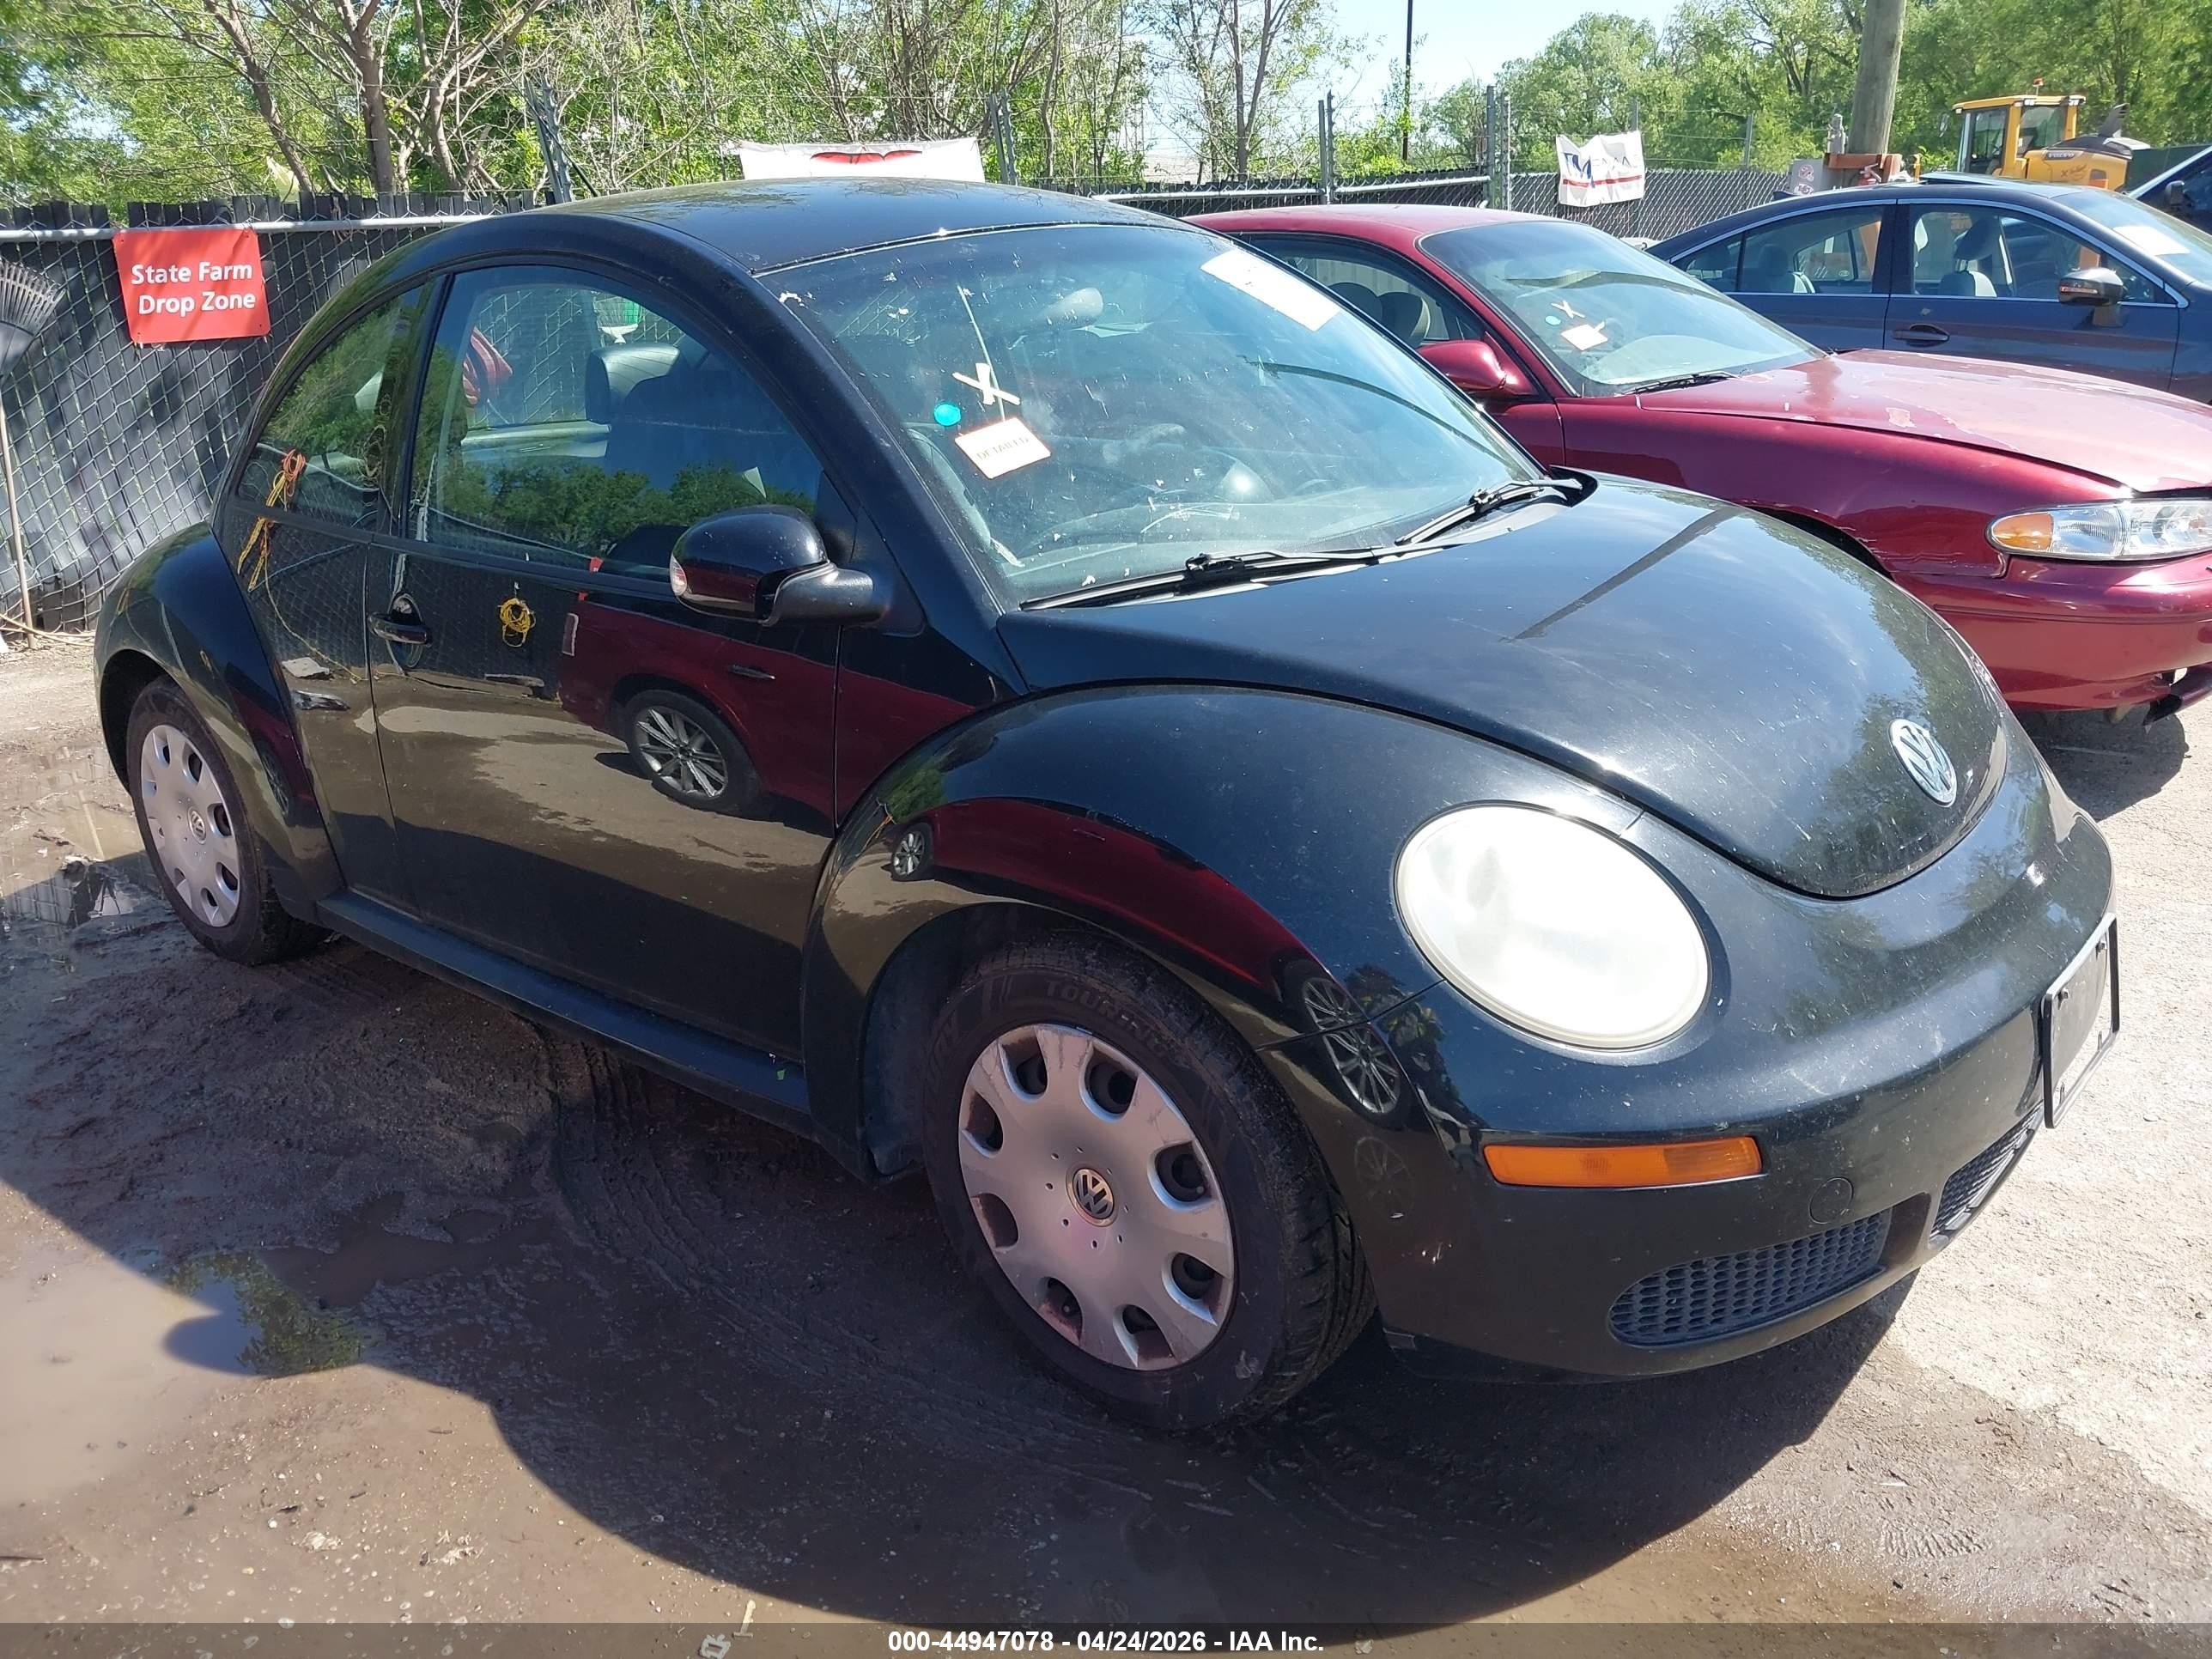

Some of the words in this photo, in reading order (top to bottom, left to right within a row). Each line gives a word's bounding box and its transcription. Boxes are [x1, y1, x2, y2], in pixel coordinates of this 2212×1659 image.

[131, 263, 191, 285] State
[198, 261, 253, 282] Farm
[138, 295, 195, 318] Drop
[201, 290, 256, 312] Zone
